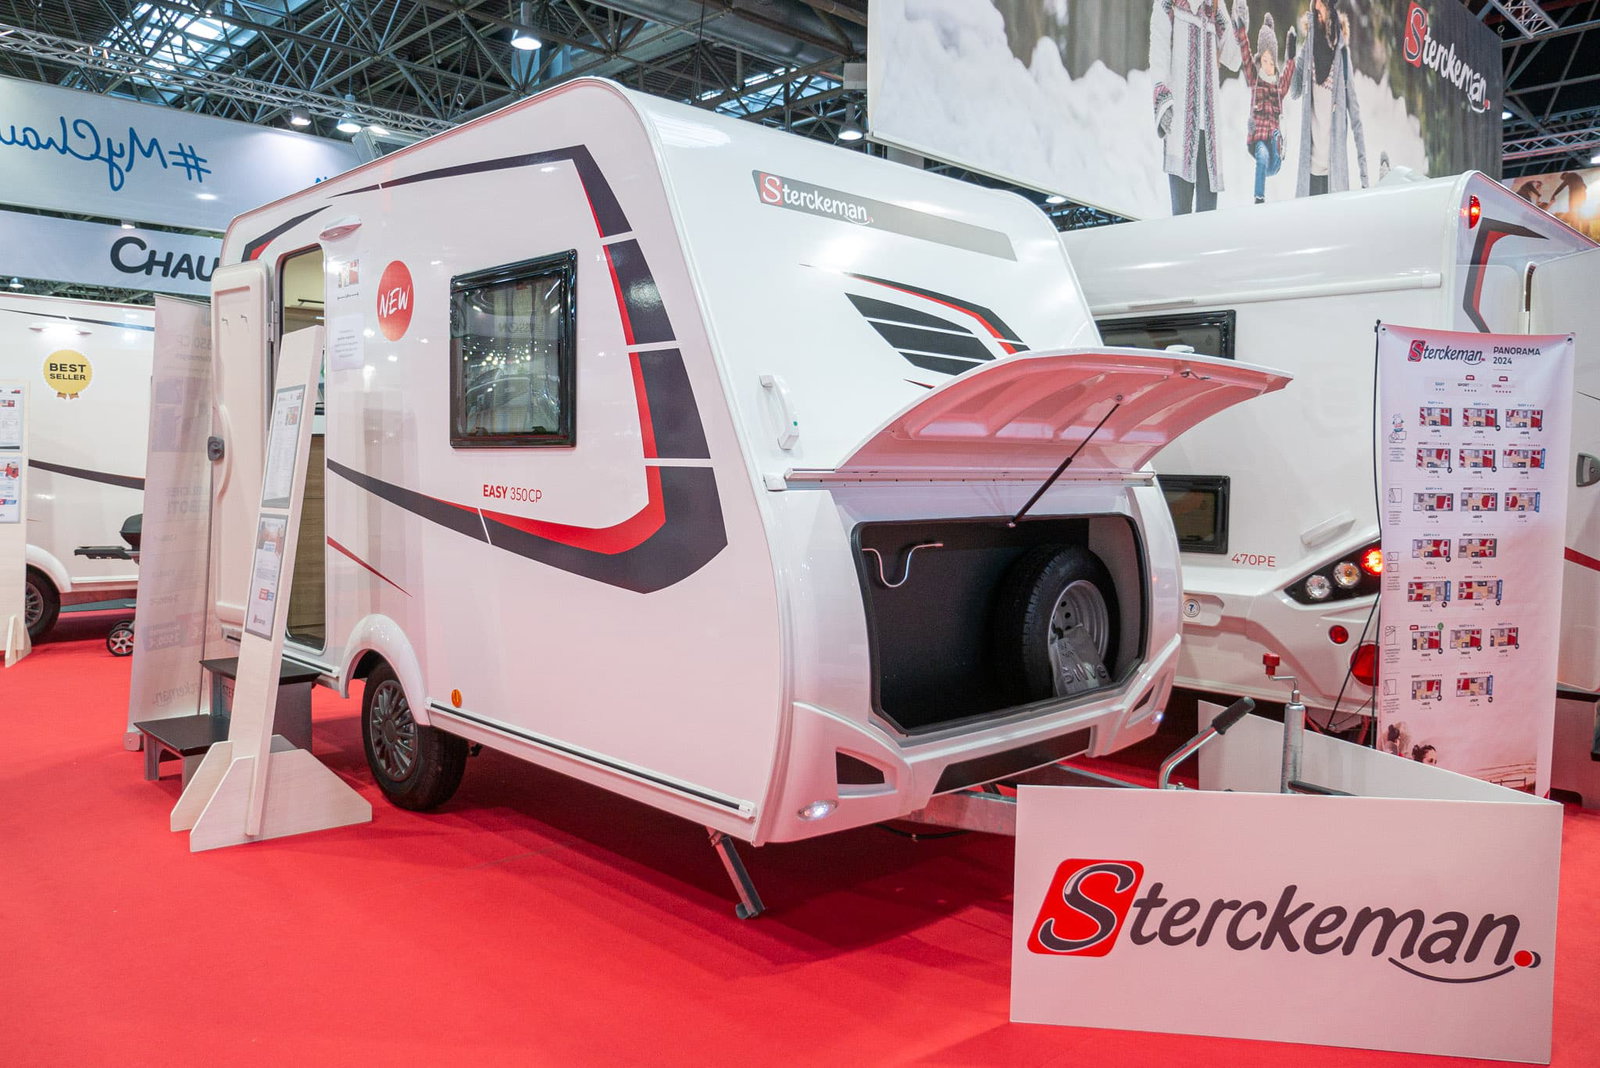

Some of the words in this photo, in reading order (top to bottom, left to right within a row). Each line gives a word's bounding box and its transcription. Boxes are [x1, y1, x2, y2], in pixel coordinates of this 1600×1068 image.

[378, 284, 411, 318] NEW
[1493, 346, 1541, 356] PANORAMA
[1492, 356, 1513, 365] 2024
[49, 362, 87, 373] BEST
[49, 373, 87, 381] SELLER
[483, 484, 508, 499] EASY
[510, 486, 543, 503] 350CP
[1231, 553, 1276, 567] 470PE
